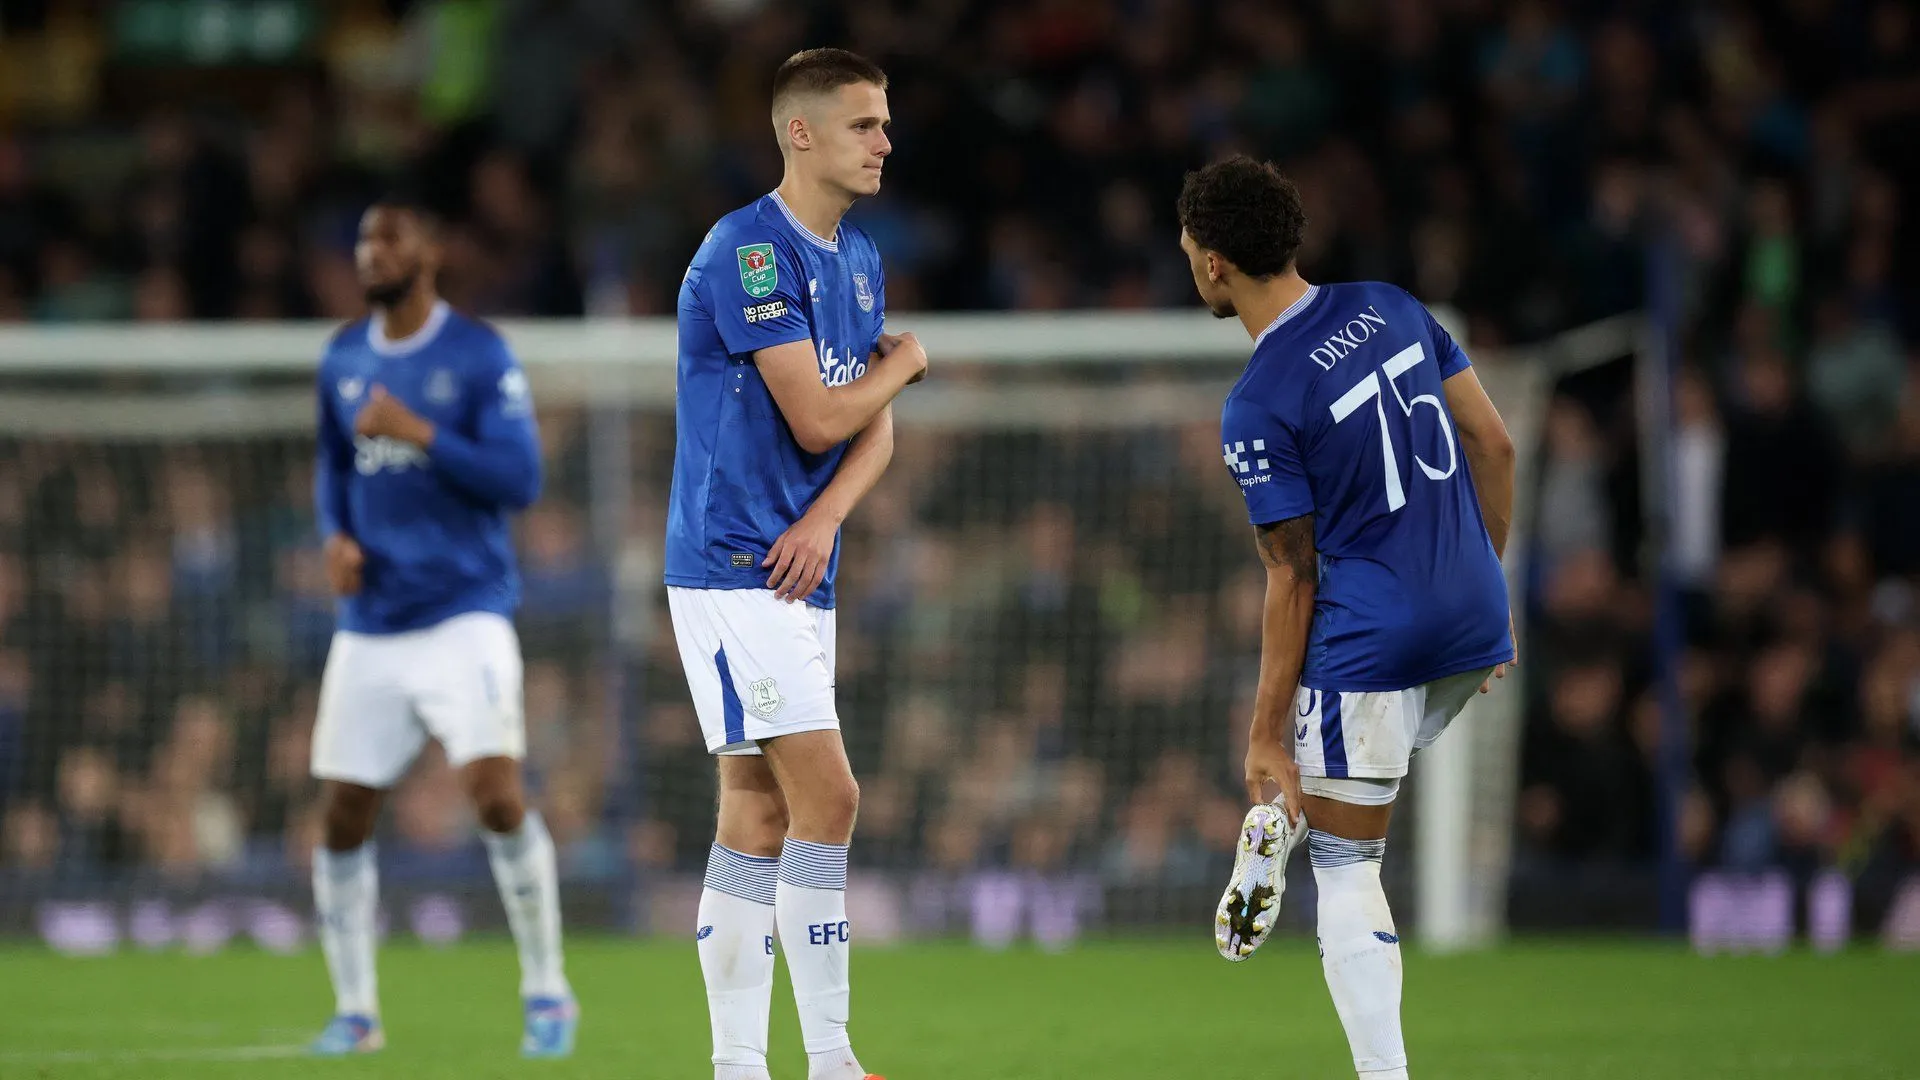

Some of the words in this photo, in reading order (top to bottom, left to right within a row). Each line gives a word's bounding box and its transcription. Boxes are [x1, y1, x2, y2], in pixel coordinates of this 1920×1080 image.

[751, 273, 766, 283] Cup
[743, 306, 757, 316] No
[757, 301, 783, 314] room
[758, 307, 788, 321] racism
[1309, 305, 1387, 371] DIXON
[820, 338, 866, 388] take
[1329, 341, 1457, 513] 75
[808, 920, 849, 945] EFC
